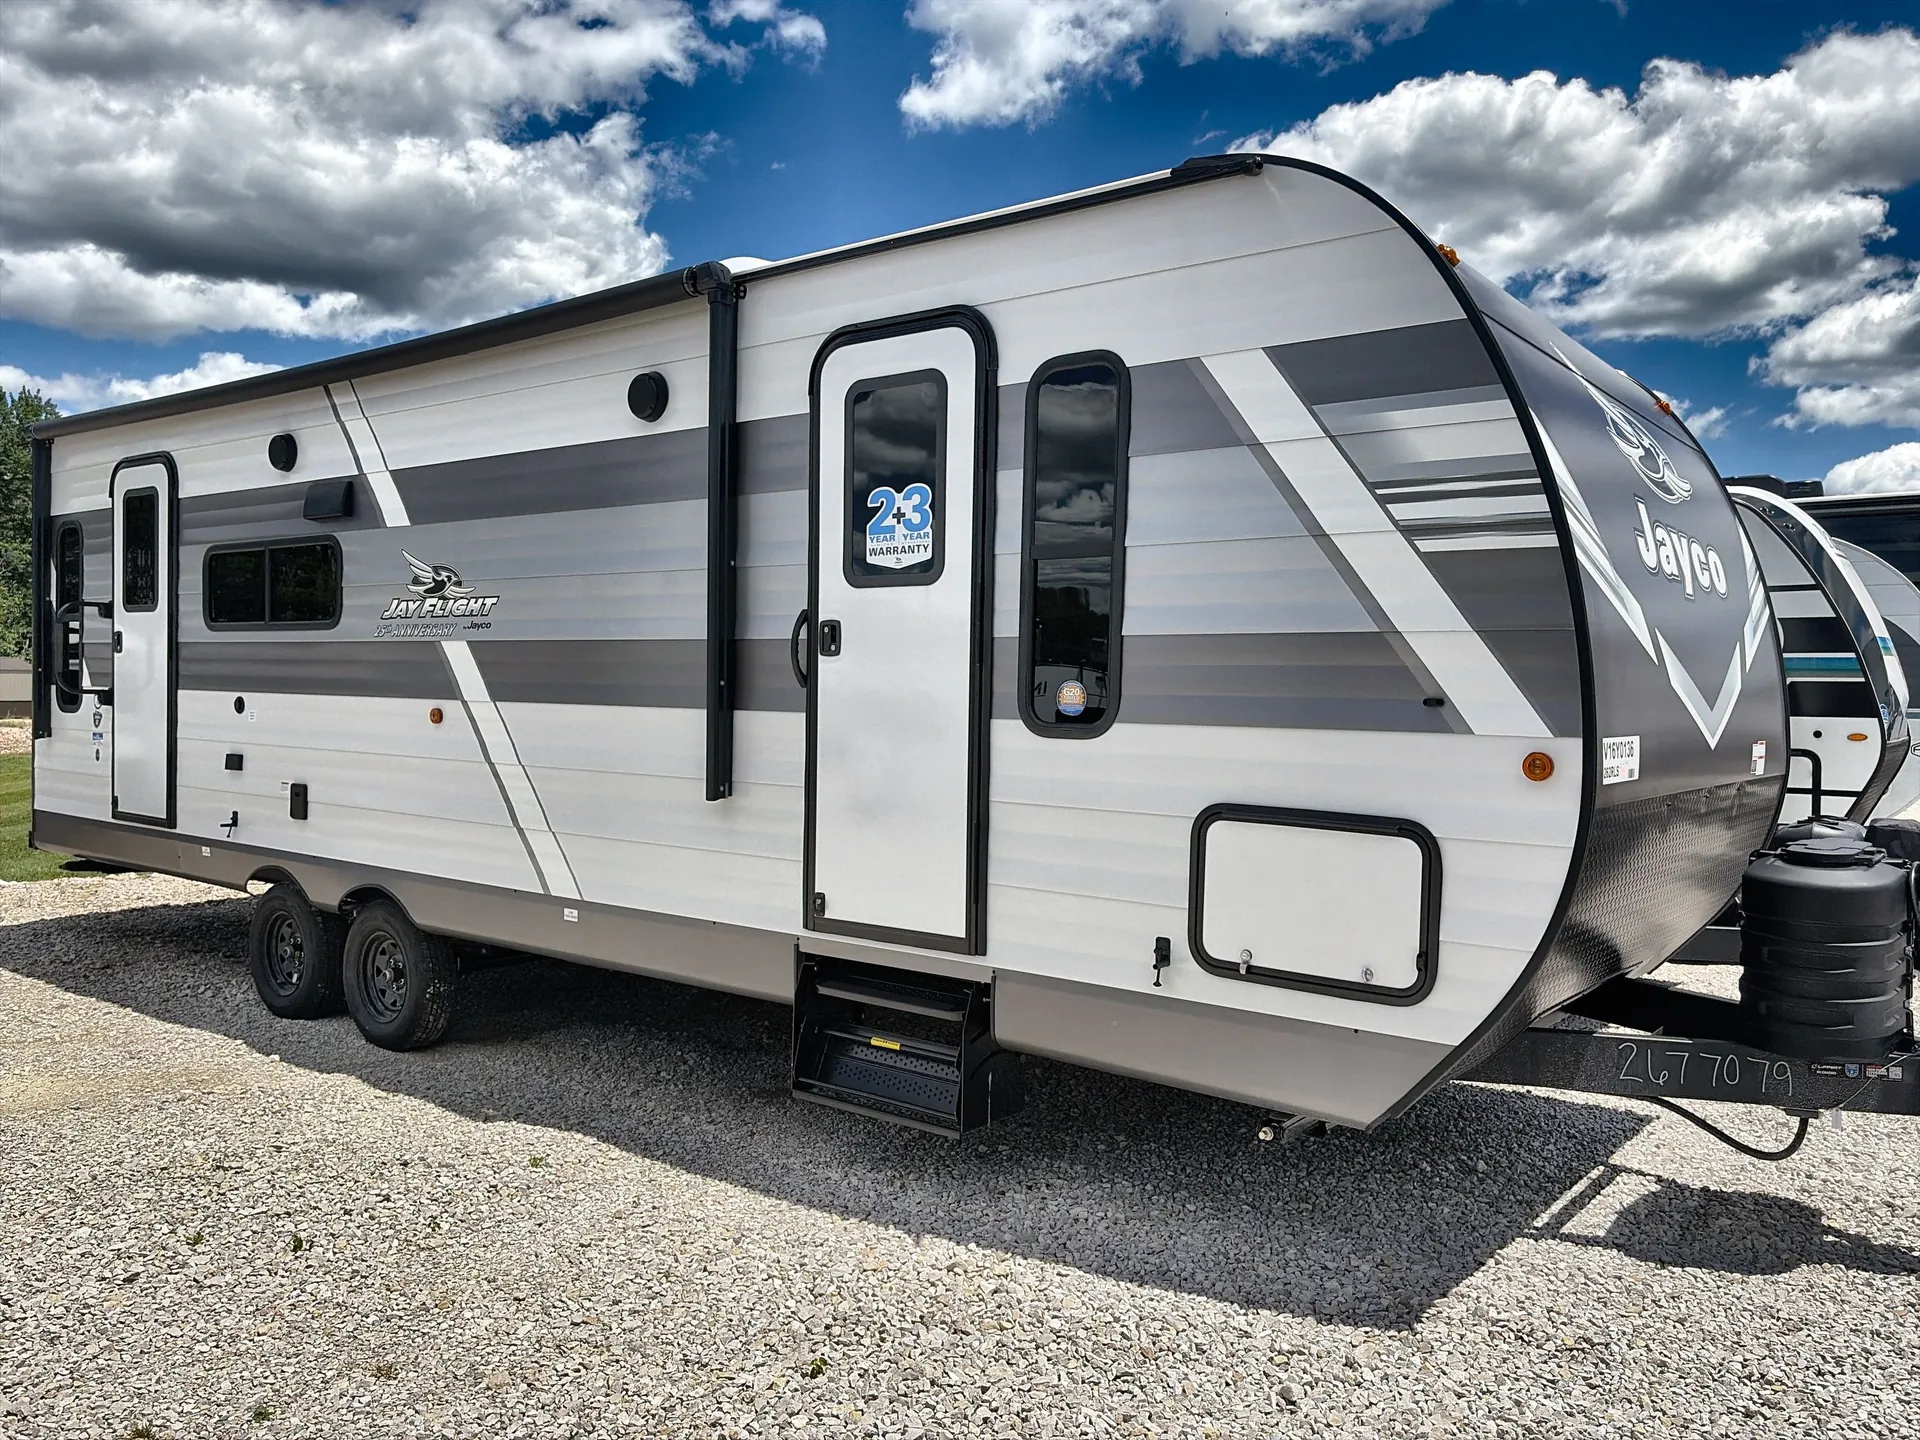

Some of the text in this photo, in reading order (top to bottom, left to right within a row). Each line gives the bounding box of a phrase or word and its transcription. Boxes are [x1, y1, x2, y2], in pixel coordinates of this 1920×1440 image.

[869, 531, 930, 543] YEAR YEAR
[868, 544, 929, 556] WARRANTY
[1633, 493, 1728, 600] Jayco
[380, 596, 500, 620] JAY FLIGHT
[391, 622, 458, 638] ANNIVERSARY
[468, 620, 492, 631] Jayco
[1063, 687, 1080, 696] G20
[1603, 740, 1634, 760] V16Y0136
